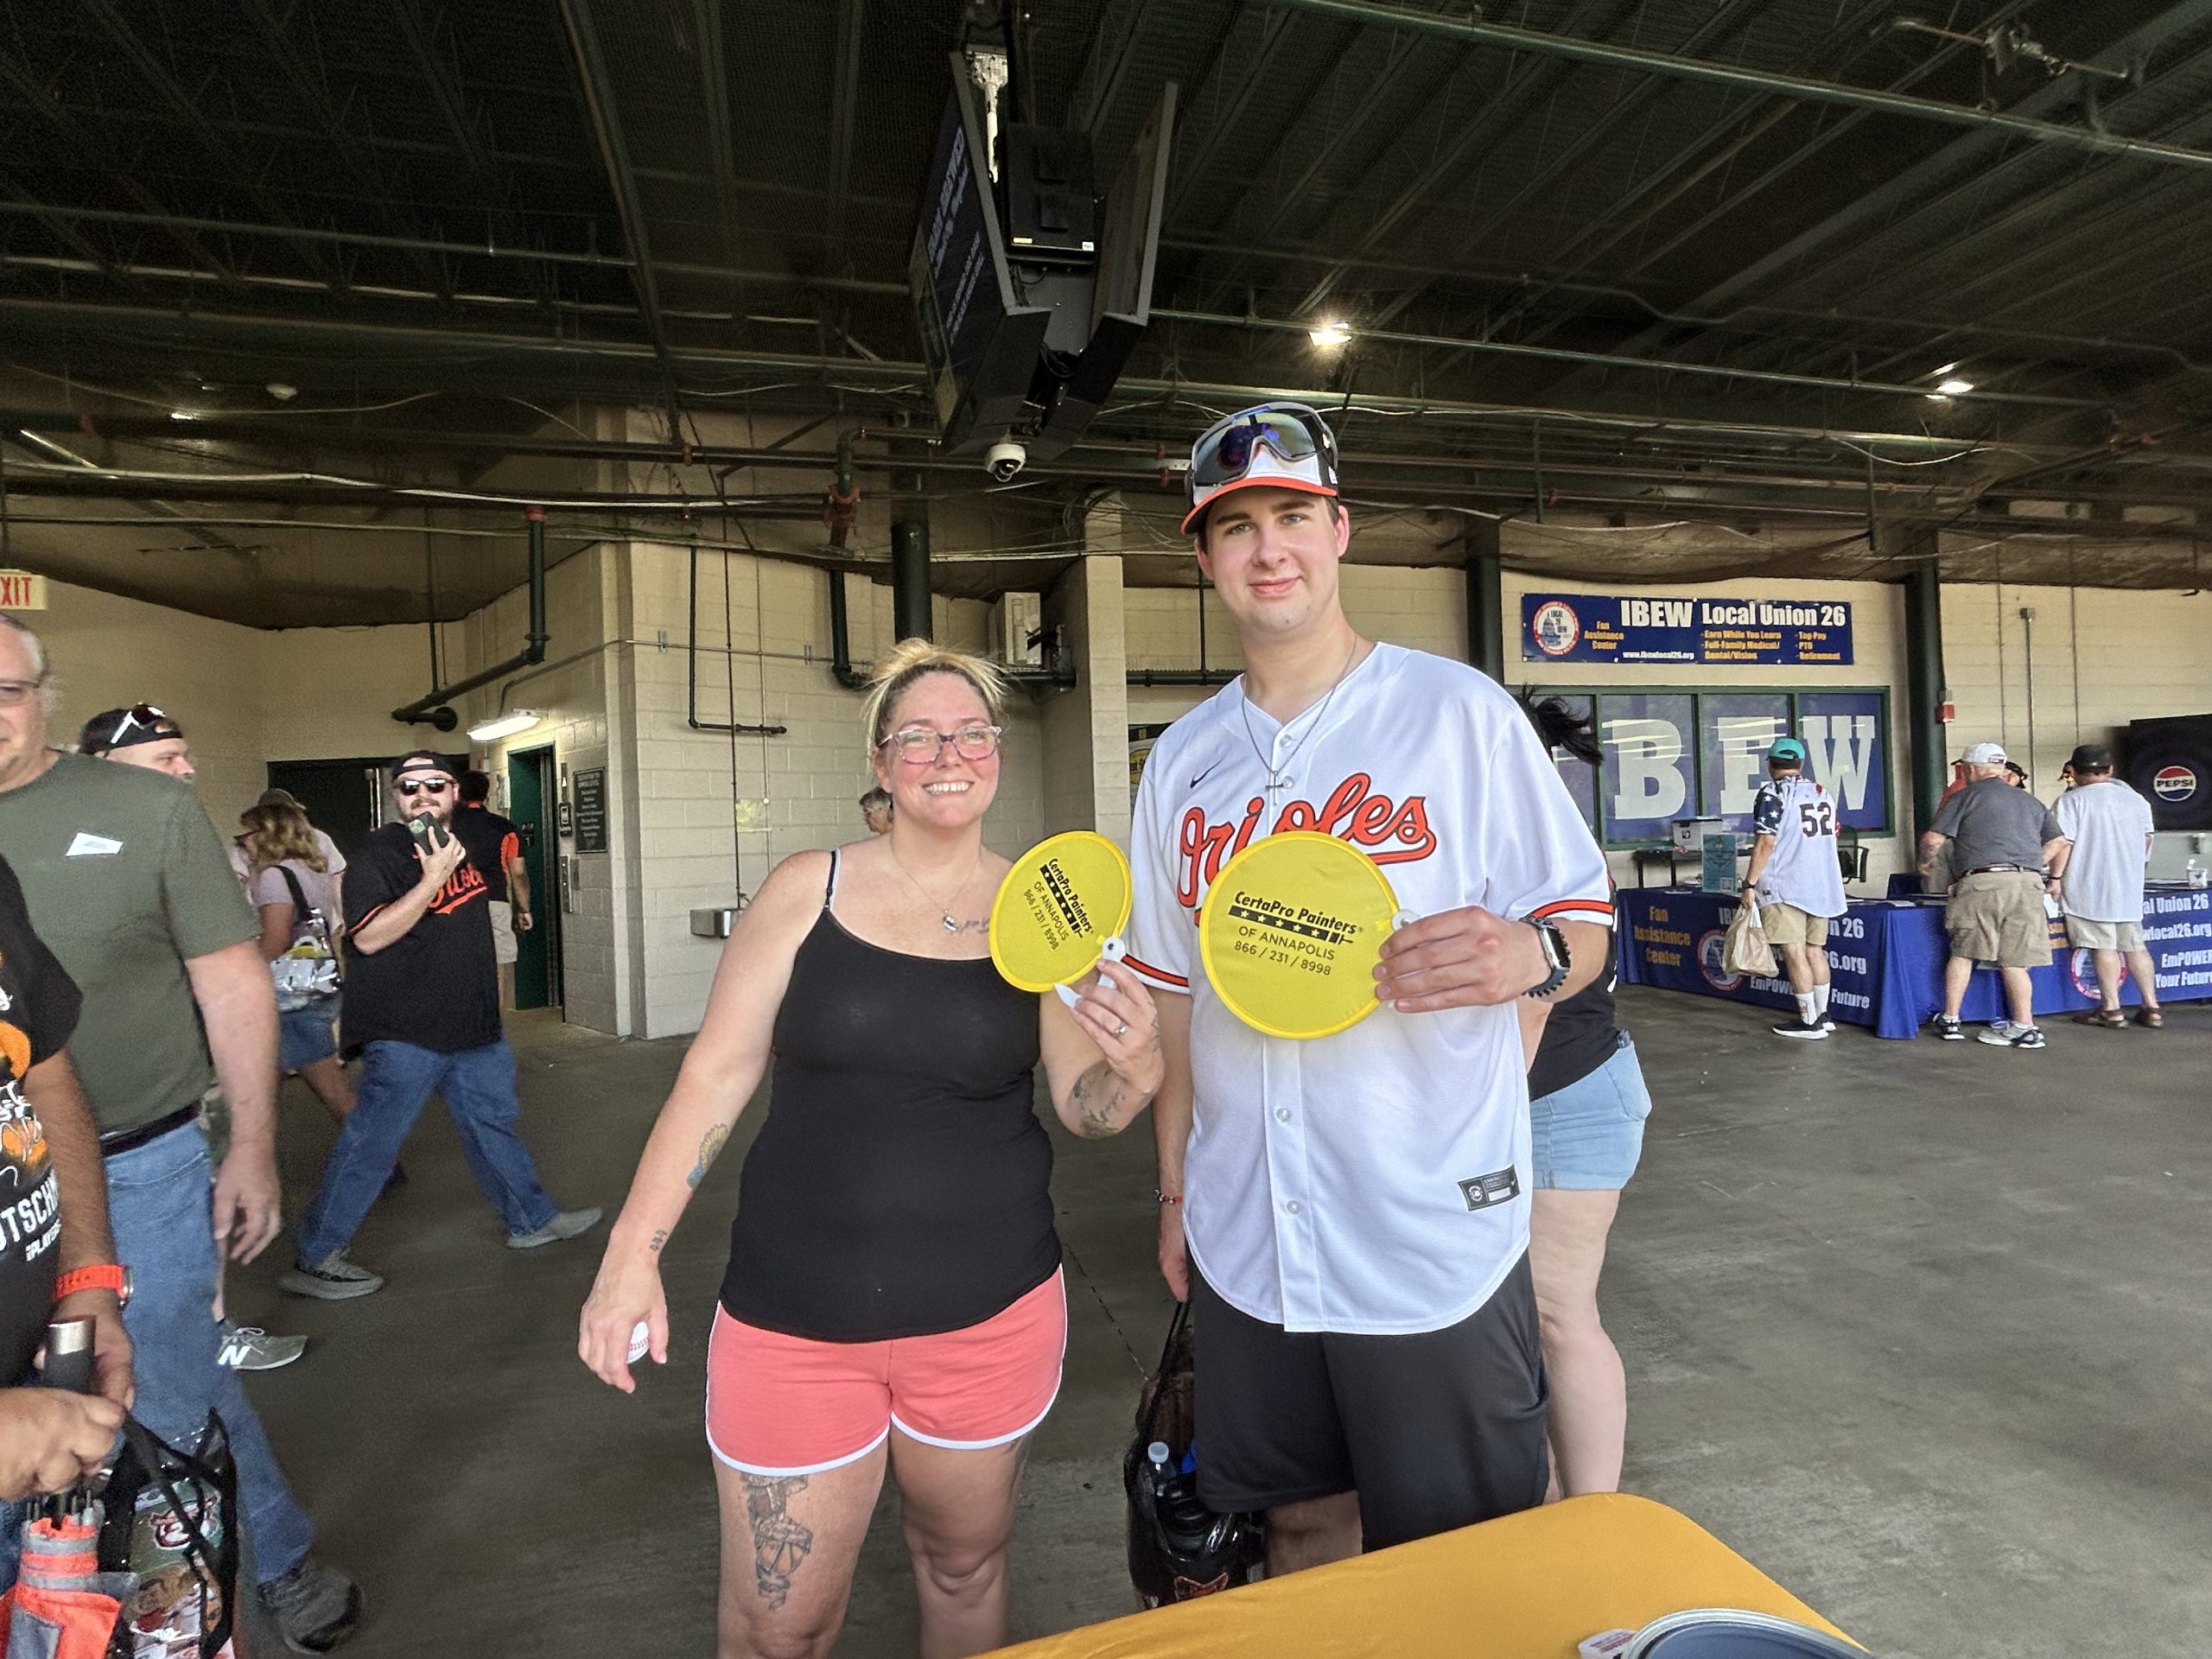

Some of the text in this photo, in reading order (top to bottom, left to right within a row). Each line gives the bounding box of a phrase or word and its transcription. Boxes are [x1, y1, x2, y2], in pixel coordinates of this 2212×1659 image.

[0, 576, 32, 606] XIT
[1621, 601, 1846, 627] IBEW Local Union 26
[1705, 630, 1722, 639] Earn
[1723, 630, 1745, 639] While
[1746, 631, 1759, 639] You
[2156, 779, 2194, 788] PEPSI
[1799, 802, 1833, 837] 52
[1048, 858, 1071, 897] CertaPro
[1033, 880, 1070, 941] OF ANNAPOLIS
[1235, 891, 1294, 918] CertaPro
[1649, 906, 1669, 922] Fan
[2155, 895, 2192, 913] Union
[2192, 893, 2209, 910] 26
[1023, 888, 1034, 906] 866
[1034, 909, 1045, 925] 231
[1044, 928, 1059, 950] 8998
[1841, 918, 1865, 939] 26
[1238, 925, 1335, 961] OF ANNAPOLIS
[1634, 925, 1691, 946] Assistance
[1234, 940, 1256, 955] 866
[1269, 950, 1288, 964] 231
[1300, 959, 1332, 976] 8998
[1645, 947, 1682, 966] Center
[2155, 974, 2180, 988] Your
[1831, 988, 1870, 1009] Future
